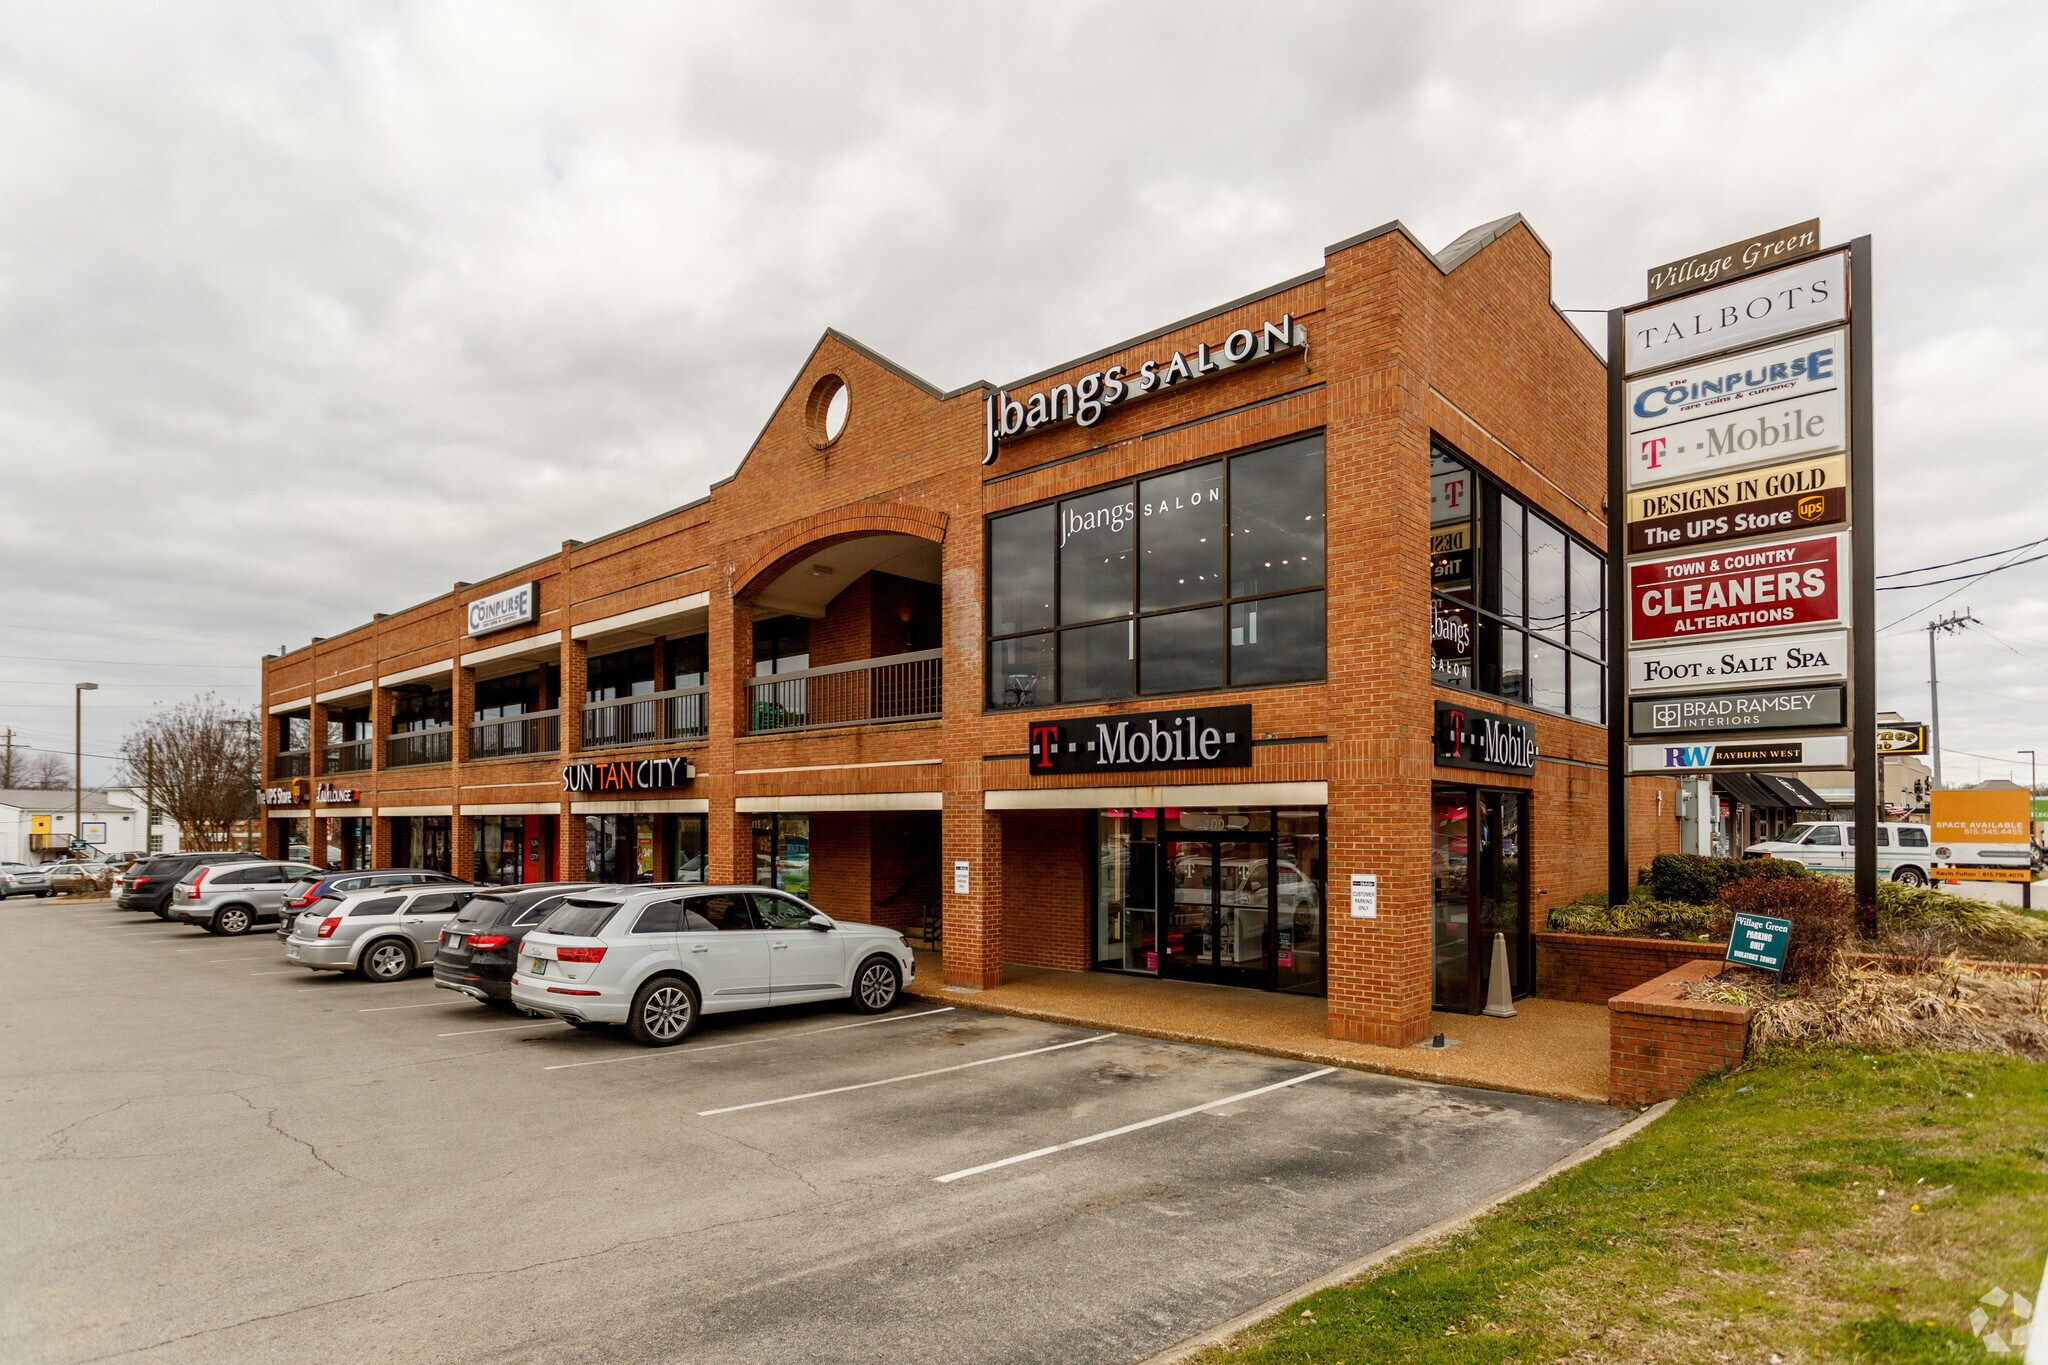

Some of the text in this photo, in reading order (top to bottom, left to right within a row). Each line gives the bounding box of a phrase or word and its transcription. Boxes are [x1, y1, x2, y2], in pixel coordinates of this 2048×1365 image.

[1650, 230, 1815, 291] Village Green
[1637, 280, 1829, 349] TALBOTS
[1140, 313, 1297, 391] SALON
[1668, 378, 1688, 388] The
[1680, 402, 1701, 412] rare
[1704, 396, 1731, 407] coins
[1748, 381, 1797, 397] currency
[1144, 488, 1220, 517] SALON
[1642, 468, 1826, 519] DESIGNS IN GOLD
[1800, 501, 1823, 518] ups
[1644, 510, 1793, 545] The UPS Store
[1665, 548, 1796, 578] TOWN & COUNTRY
[1641, 568, 1826, 617] CLEANERS
[1674, 607, 1795, 633] ALTERATIONS
[1431, 656, 1467, 678] SALON
[1644, 647, 1830, 681] FOOT & SALT SPA
[1683, 694, 1816, 717] BRAD RAMSEY
[1683, 715, 1760, 728] INTERIORS
[1664, 745, 1712, 768] RW
[1716, 749, 1800, 760] RAYBURN WEST
[562, 757, 682, 792] SUN TAN CITY
[1736, 916, 1788, 932] Village Green
[1746, 930, 1772, 942] PARKING
[1750, 941, 1765, 951] ONLY
[1760, 955, 1777, 965] TOWED
